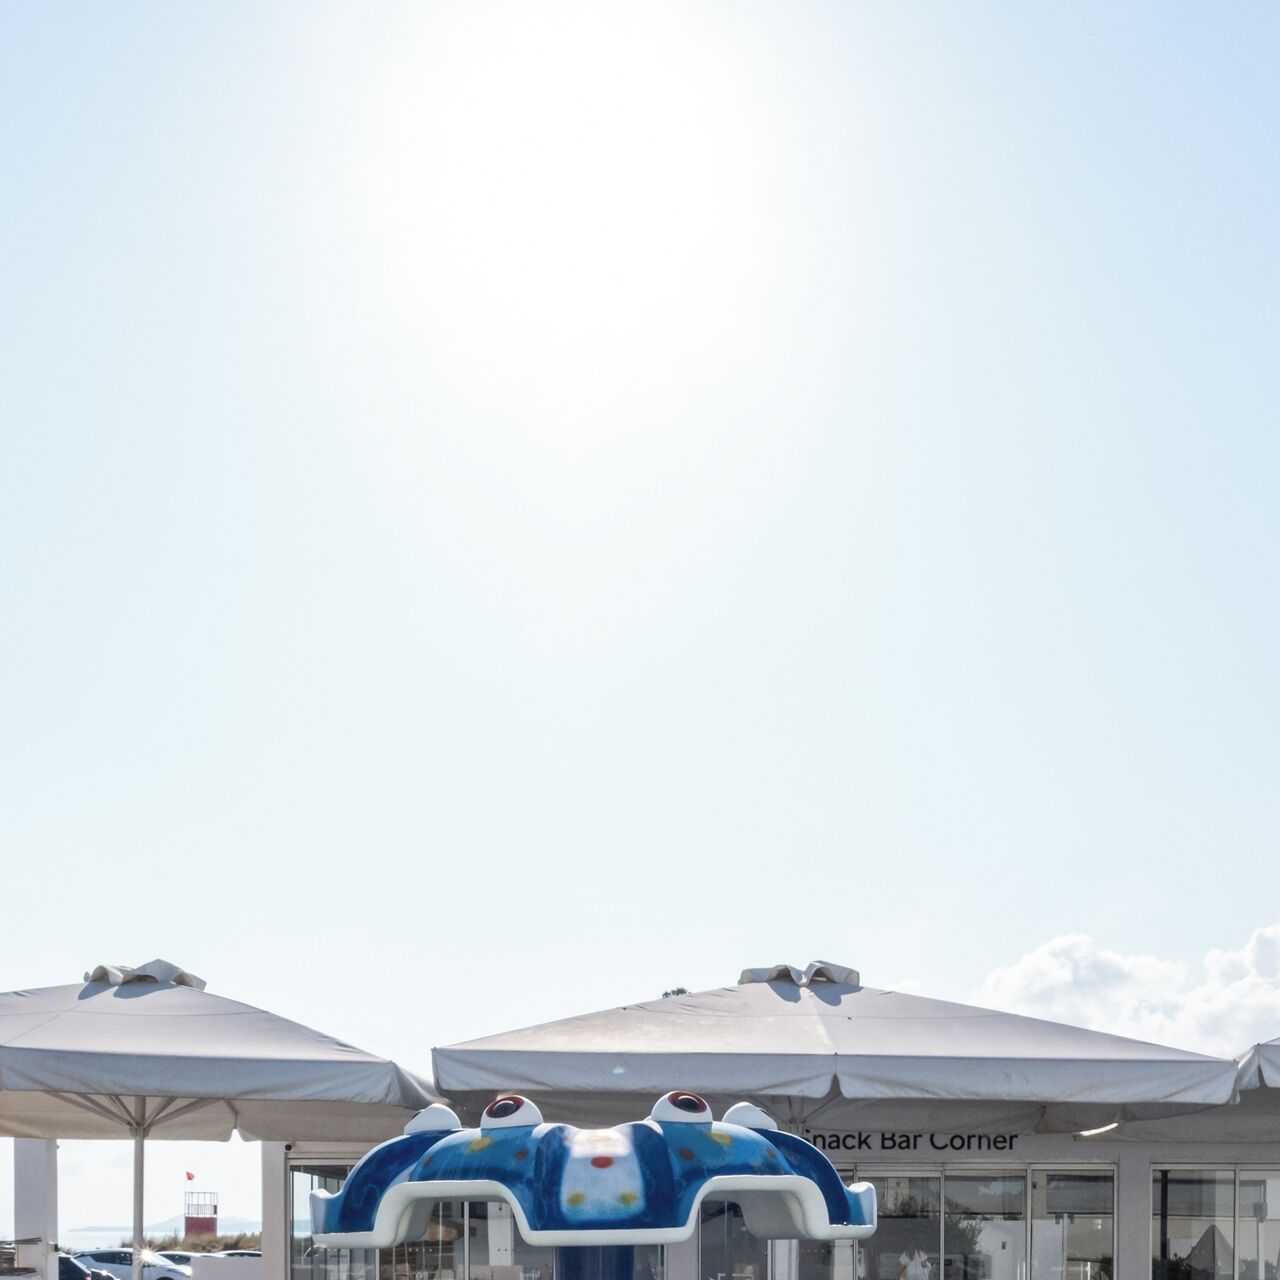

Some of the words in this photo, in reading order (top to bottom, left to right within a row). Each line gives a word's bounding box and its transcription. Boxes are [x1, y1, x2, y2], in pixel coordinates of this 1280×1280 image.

[805, 1129, 872, 1150] nack
[881, 1131, 923, 1150] Bar
[929, 1132, 1019, 1150] Corner
